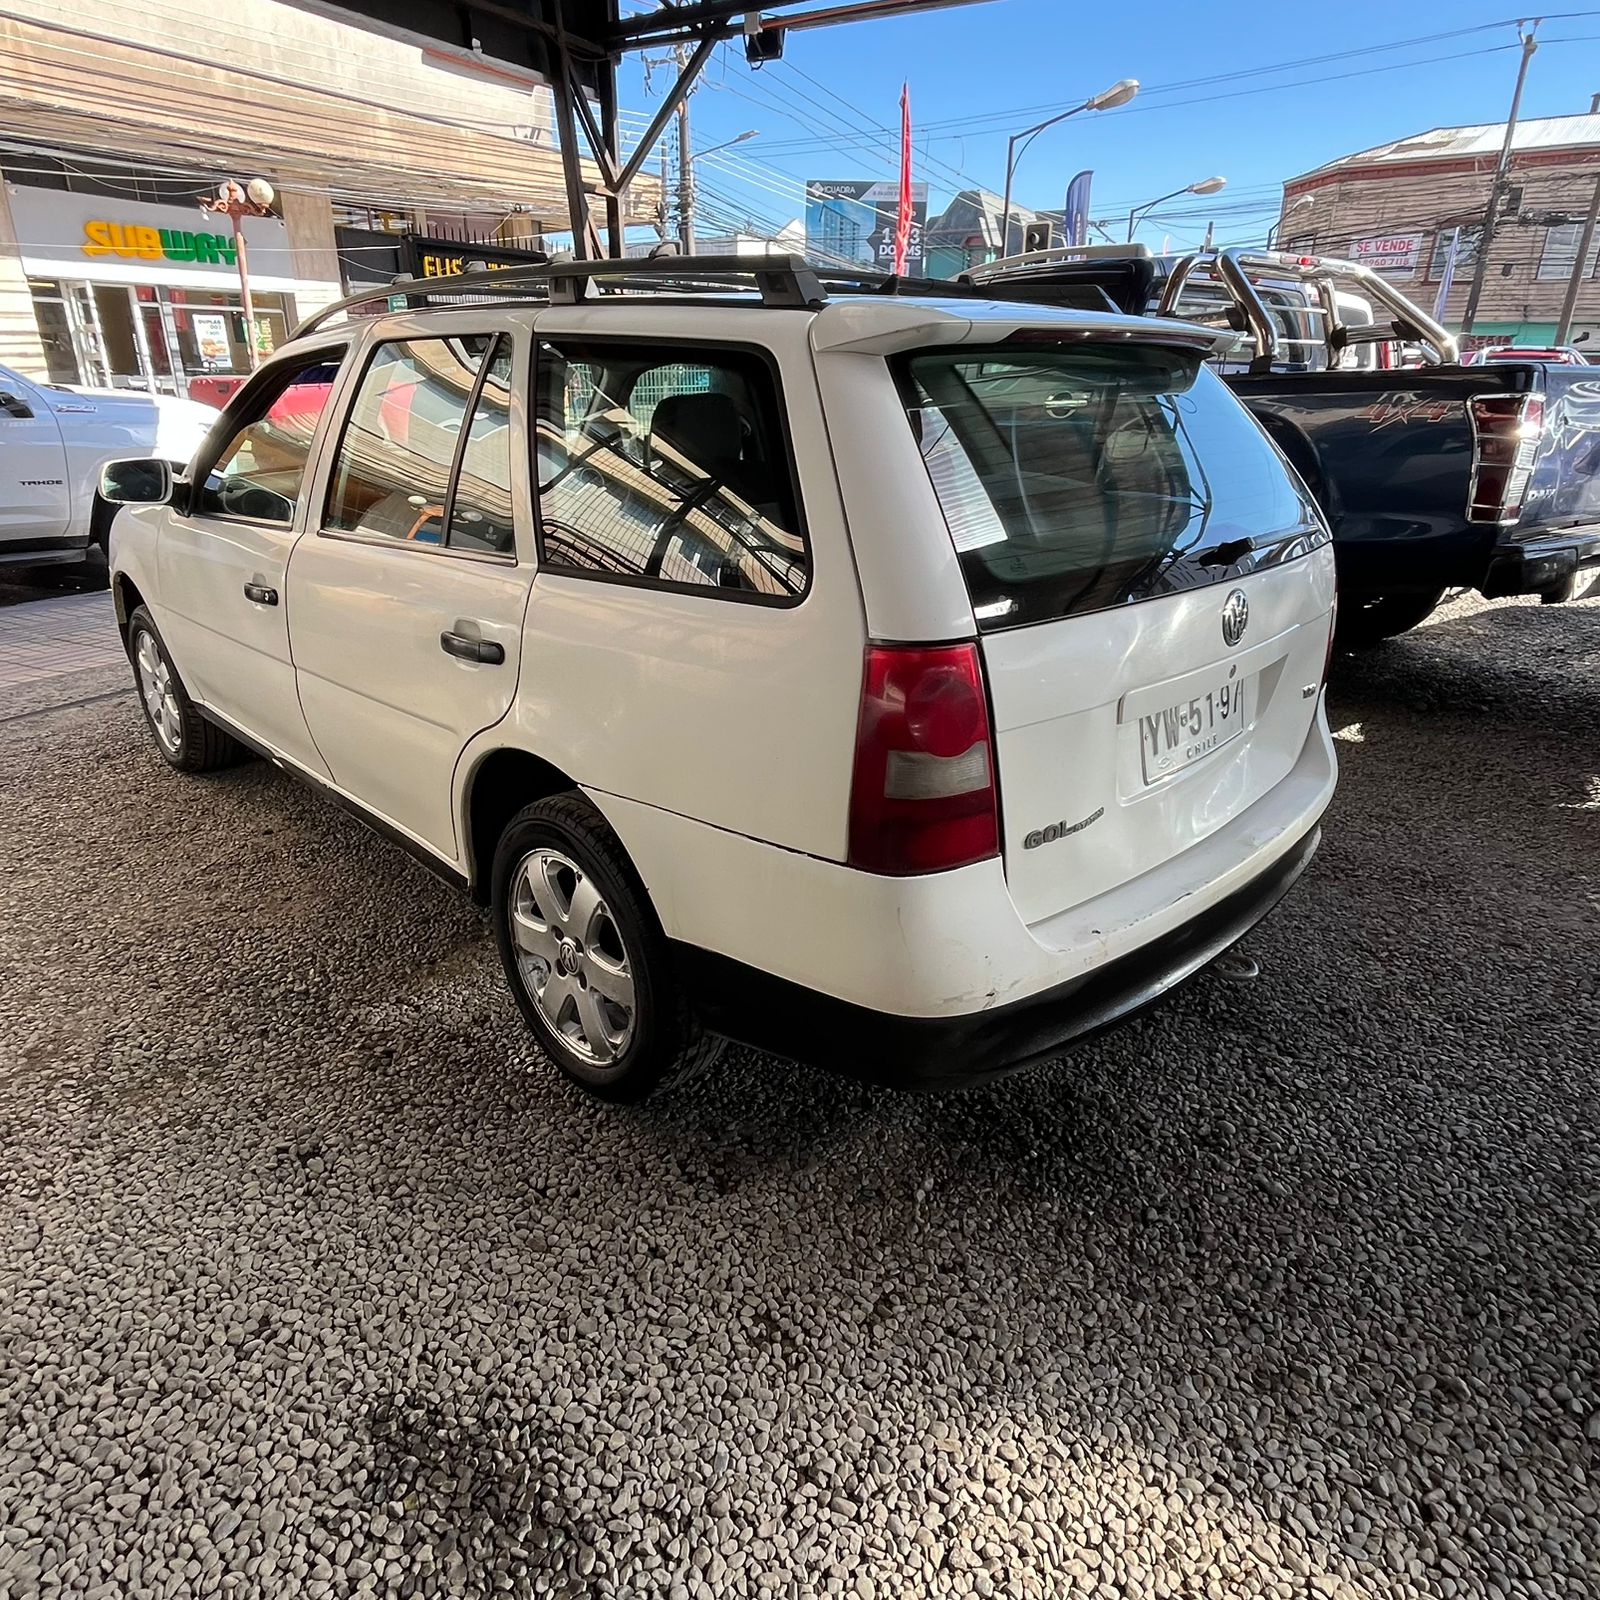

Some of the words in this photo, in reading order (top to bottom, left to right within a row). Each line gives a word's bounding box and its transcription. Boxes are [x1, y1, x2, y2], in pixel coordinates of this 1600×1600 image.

[82, 220, 237, 266] SUBWAY
[879, 244, 922, 256] DOMS
[1356, 241, 1371, 253] SE
[1375, 240, 1414, 252] VENDE
[1186, 734, 1218, 759] CHILE
